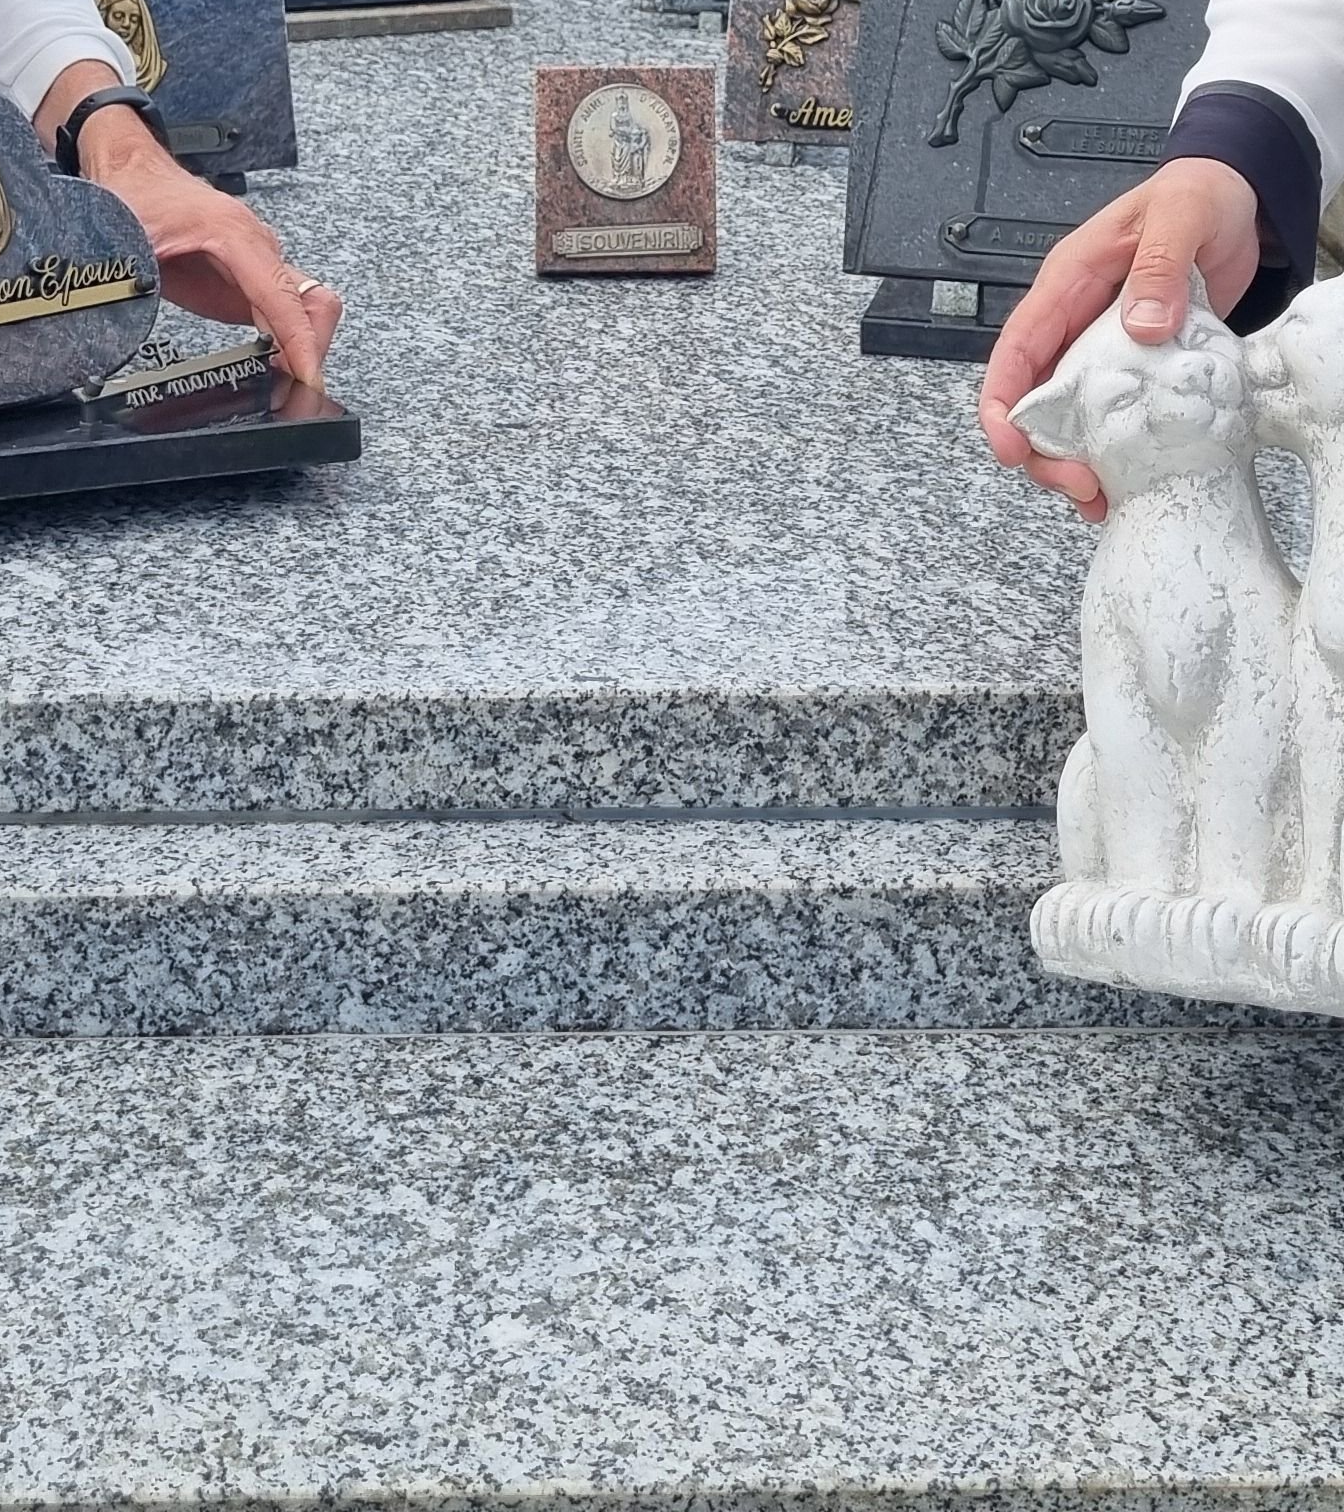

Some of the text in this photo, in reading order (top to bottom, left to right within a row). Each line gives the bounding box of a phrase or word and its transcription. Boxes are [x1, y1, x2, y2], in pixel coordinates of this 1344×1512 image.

[578, 230, 678, 251] SOUVENIR
[32, 254, 139, 306] Epouse
[125, 355, 267, 409] me manques
